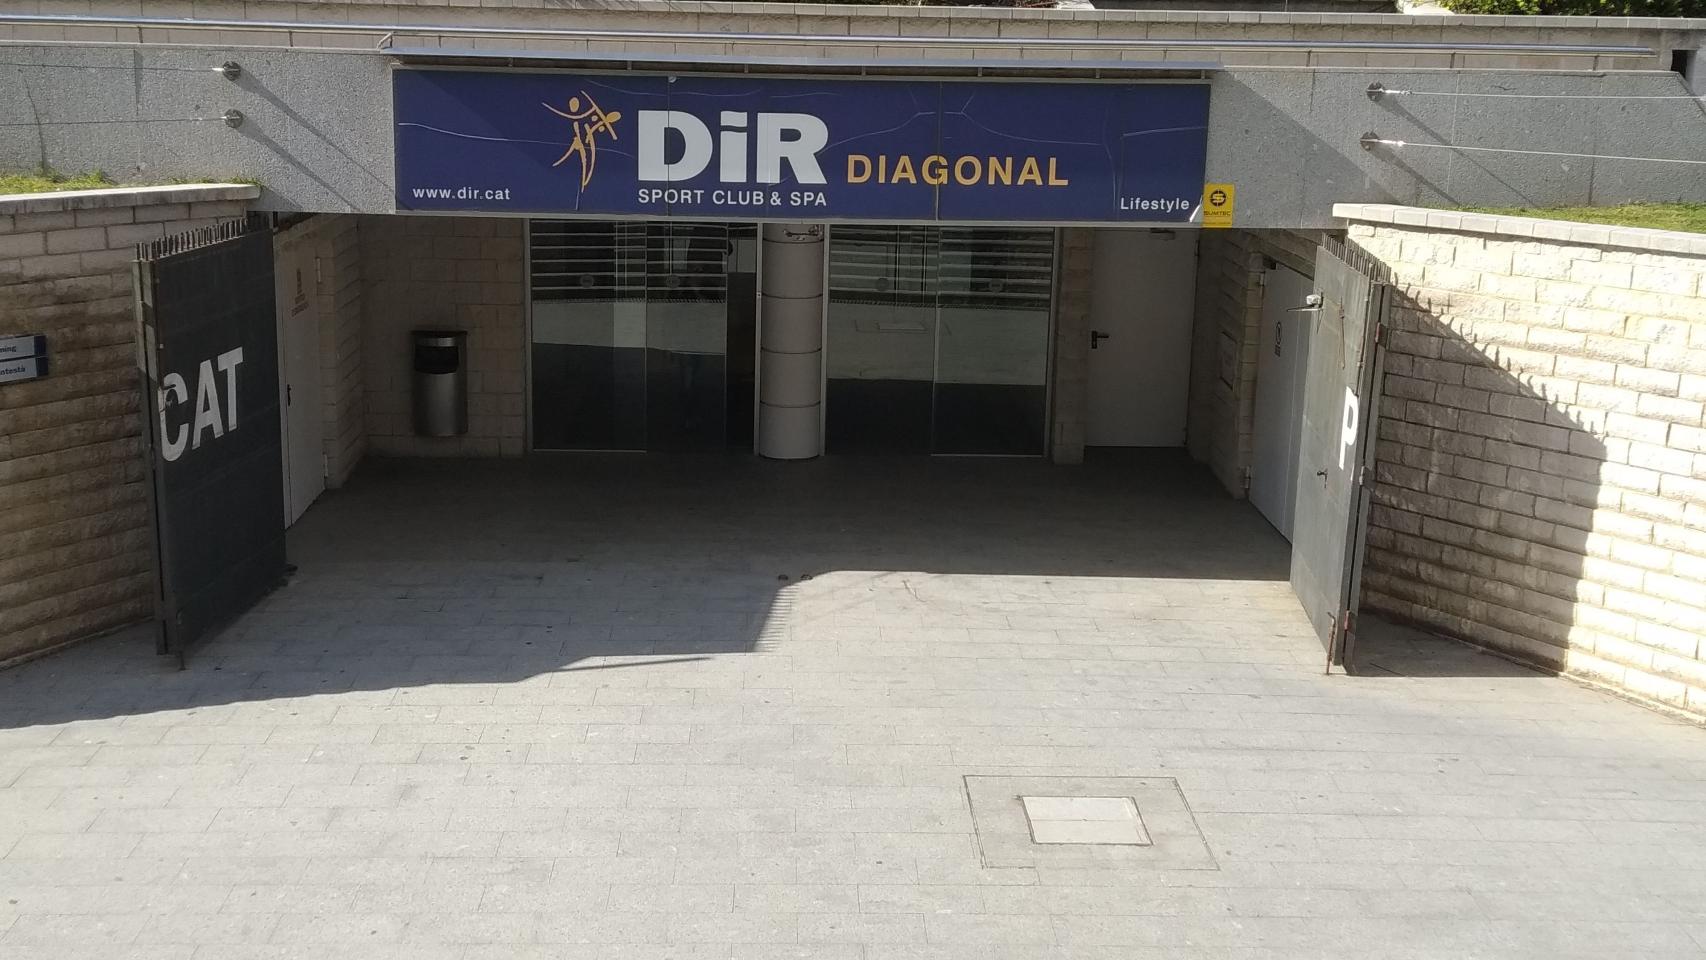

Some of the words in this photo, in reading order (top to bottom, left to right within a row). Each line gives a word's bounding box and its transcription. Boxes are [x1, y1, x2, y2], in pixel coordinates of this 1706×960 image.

[638, 110, 829, 185] DiR
[846, 154, 1069, 187] DIAGONAL
[412, 187, 511, 201] www.dir.cat
[638, 189, 704, 205] SPORT
[712, 190, 764, 206] CLUB
[770, 191, 781, 206] &
[790, 192, 828, 207] SPA
[1120, 197, 1190, 213] Lifestyle
[157, 346, 244, 462] CAT
